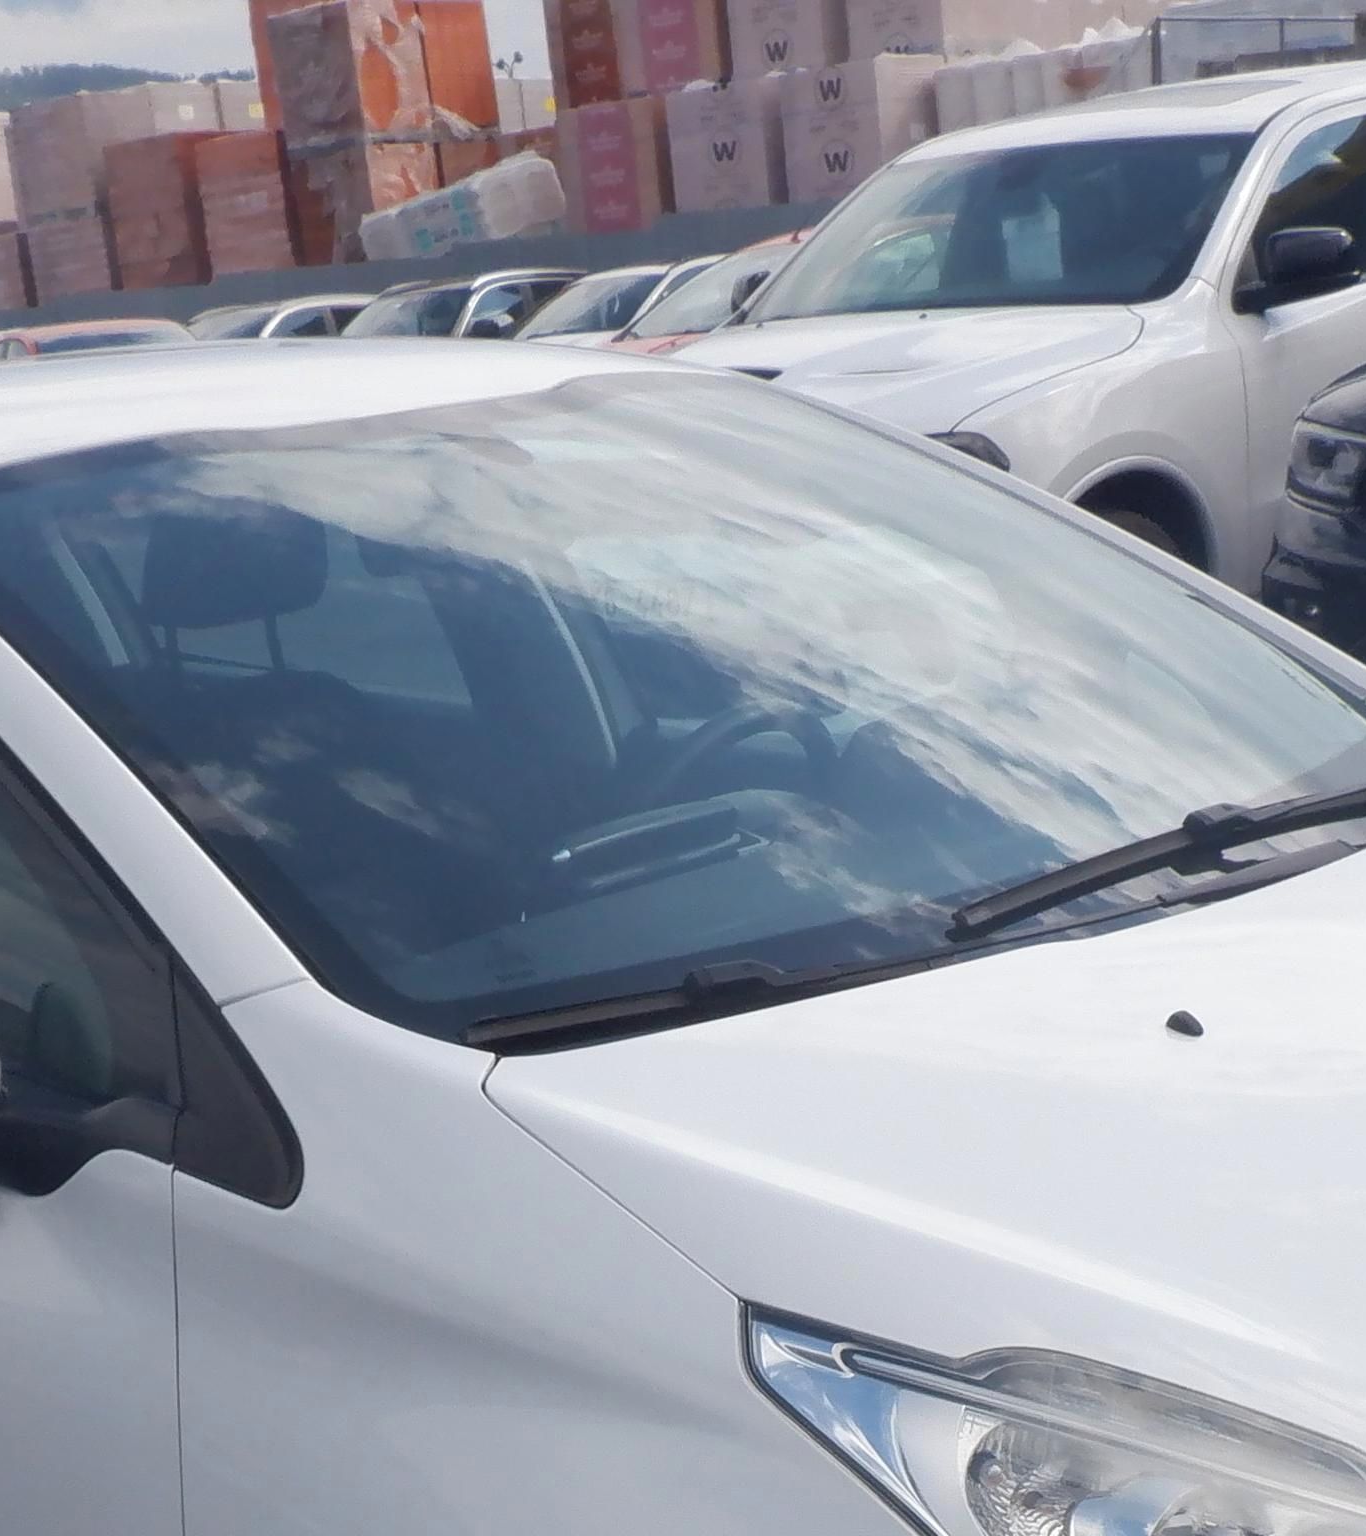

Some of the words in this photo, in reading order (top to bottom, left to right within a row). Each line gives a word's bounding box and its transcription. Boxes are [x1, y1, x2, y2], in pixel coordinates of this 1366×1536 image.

[765, 40, 788, 63] W
[819, 77, 841, 101] W
[713, 139, 736, 162] W
[824, 150, 848, 173] W
